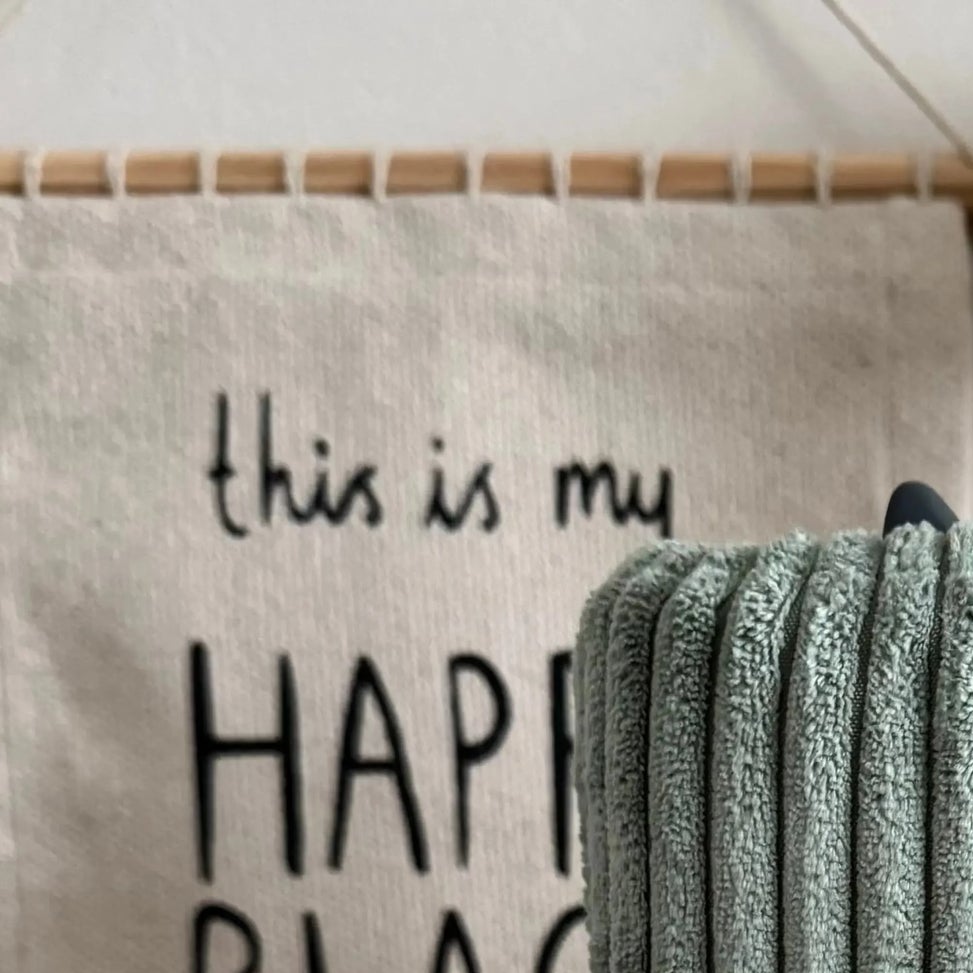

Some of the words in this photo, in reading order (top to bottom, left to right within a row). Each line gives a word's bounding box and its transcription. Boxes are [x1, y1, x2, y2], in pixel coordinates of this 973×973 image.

[208, 392, 383, 538] this
[424, 436, 500, 532] is
[554, 457, 672, 538] my
